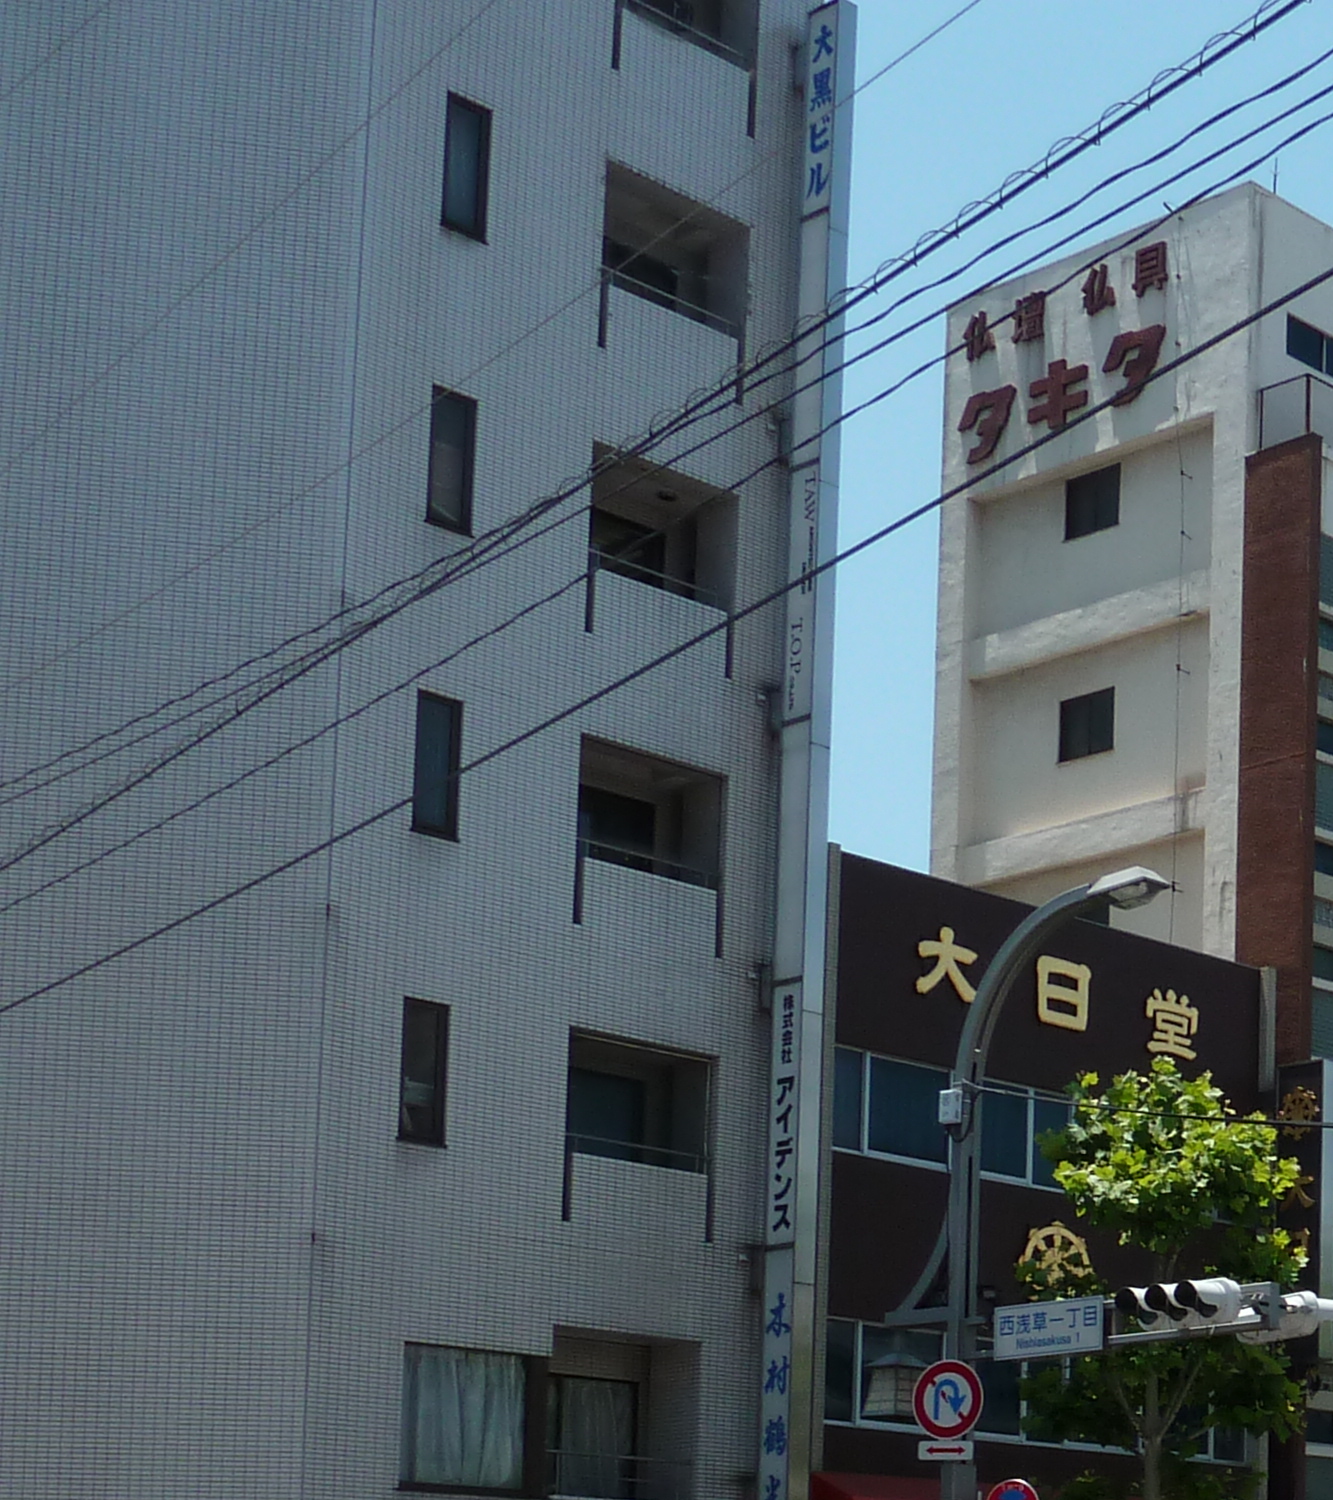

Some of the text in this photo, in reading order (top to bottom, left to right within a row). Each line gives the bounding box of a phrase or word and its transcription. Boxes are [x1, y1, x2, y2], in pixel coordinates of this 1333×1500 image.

[806, 24, 834, 199] 大黒ビル
[962, 240, 1169, 362] 仏壇 仏具
[957, 323, 1167, 465] タキタ
[915, 926, 1199, 1061] 大日堂
[999, 1306, 1098, 1336] 西浅草一丁目
